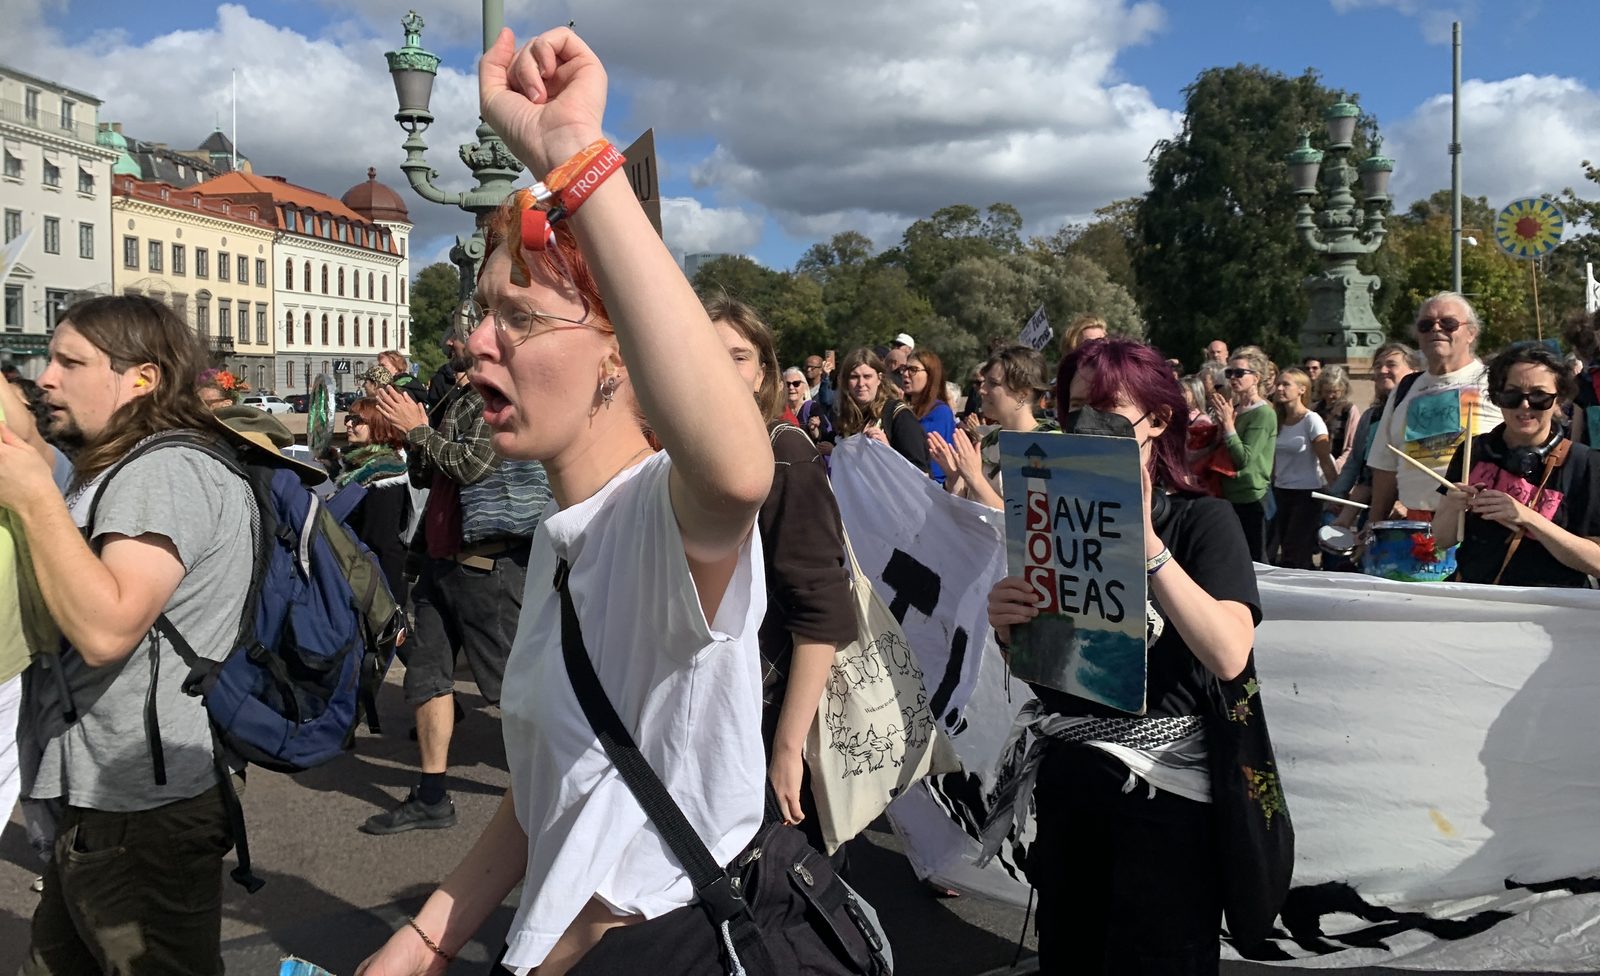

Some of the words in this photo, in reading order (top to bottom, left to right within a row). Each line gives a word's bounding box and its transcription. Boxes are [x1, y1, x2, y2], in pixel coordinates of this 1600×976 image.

[1028, 491, 1121, 539] SAVE
[1028, 532, 1103, 573] OUR
[1030, 570, 1126, 623] SEAS
